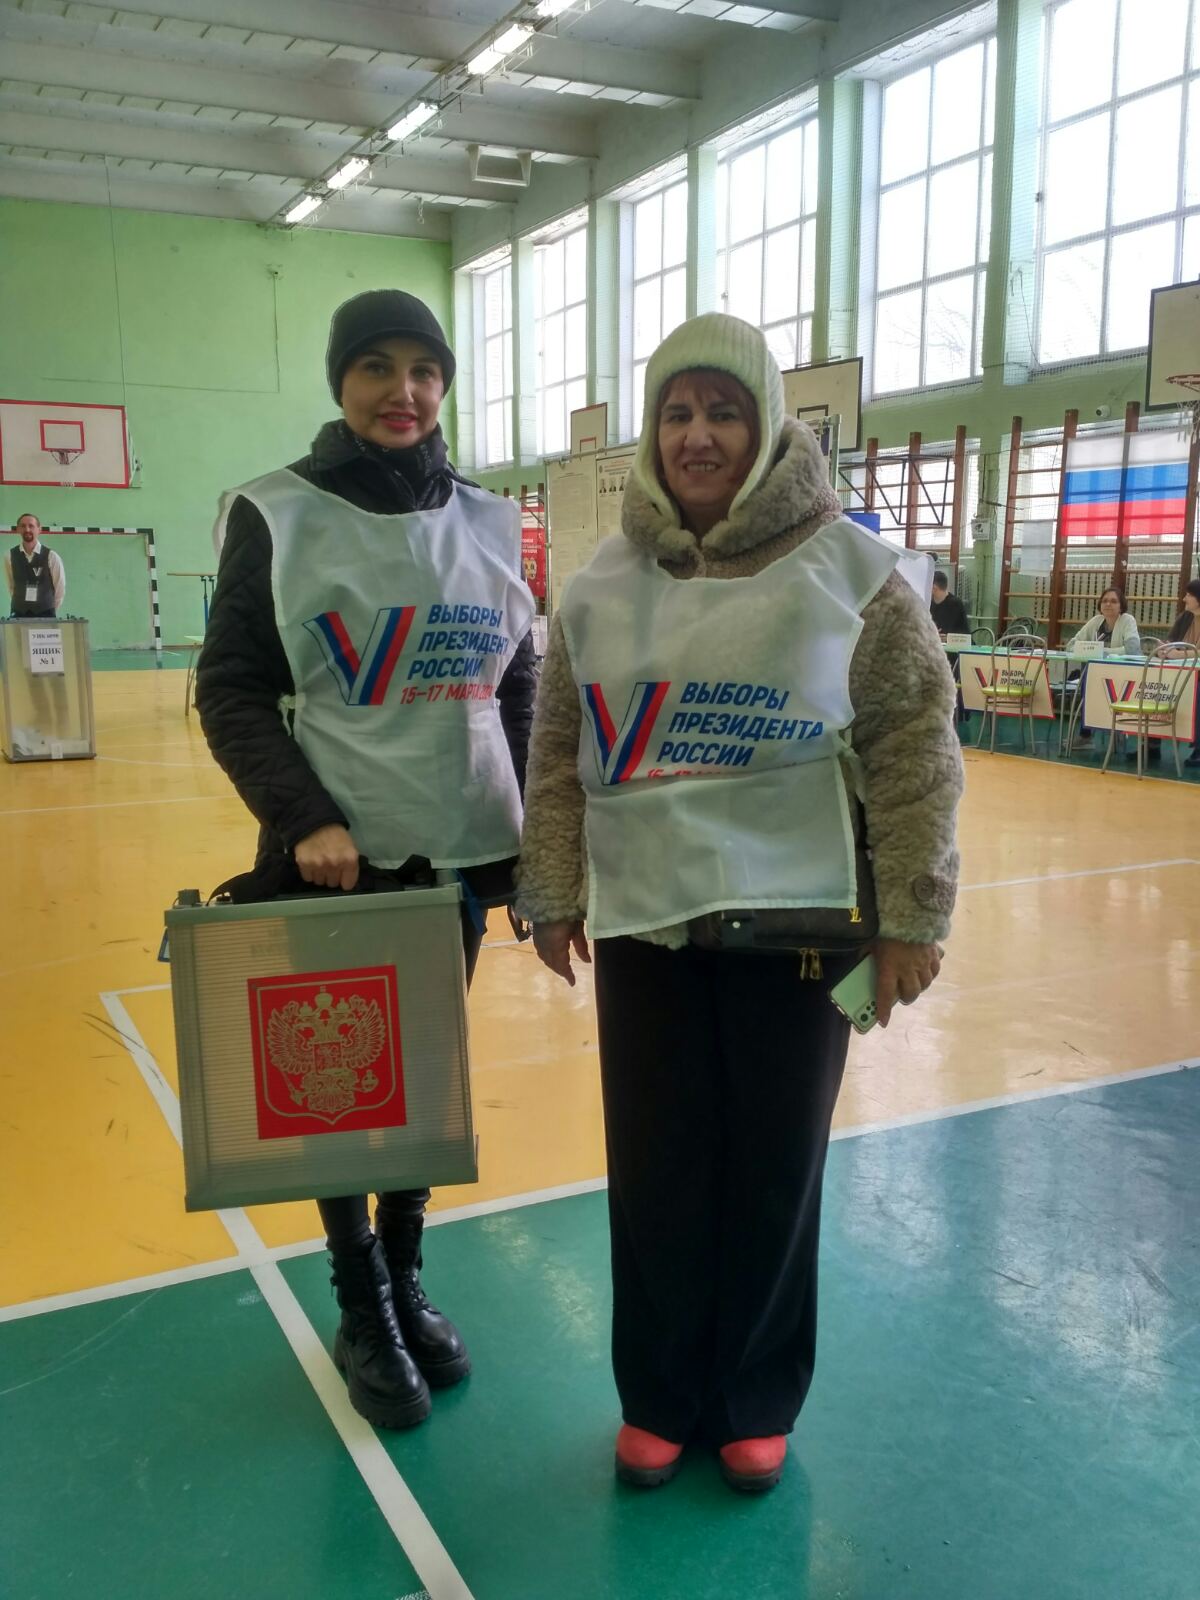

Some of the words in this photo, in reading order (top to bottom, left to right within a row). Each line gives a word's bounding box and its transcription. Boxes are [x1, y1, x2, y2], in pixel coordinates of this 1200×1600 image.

[427, 604, 503, 628] ВЫБОРЫ
[32, 647, 61, 655] ЯЩИК
[407, 657, 484, 680] РОССИИ
[680, 681, 790, 711] ВЫБОРЫ
[668, 712, 824, 742] ПРЕЗИДЕНТА
[656, 741, 756, 768] РОССИИ
